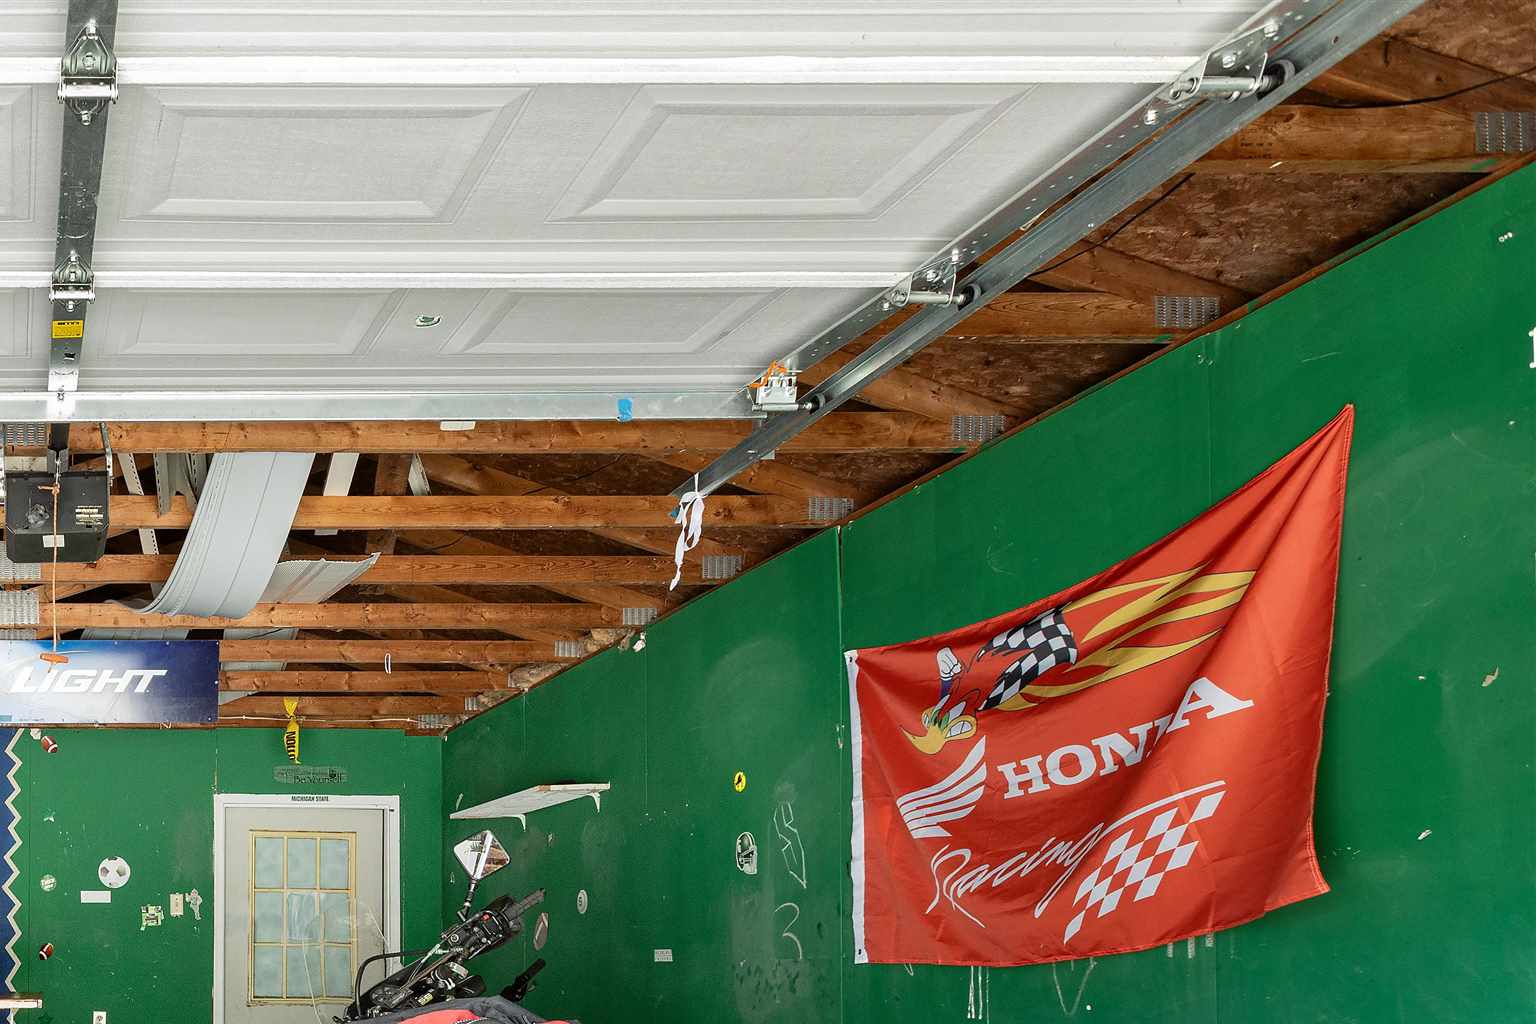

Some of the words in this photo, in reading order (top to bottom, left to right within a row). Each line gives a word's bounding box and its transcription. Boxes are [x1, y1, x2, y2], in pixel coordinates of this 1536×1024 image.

[10, 666, 168, 694] LIGHT
[997, 676, 1256, 800] HONA
[925, 822, 1105, 929] Racing
